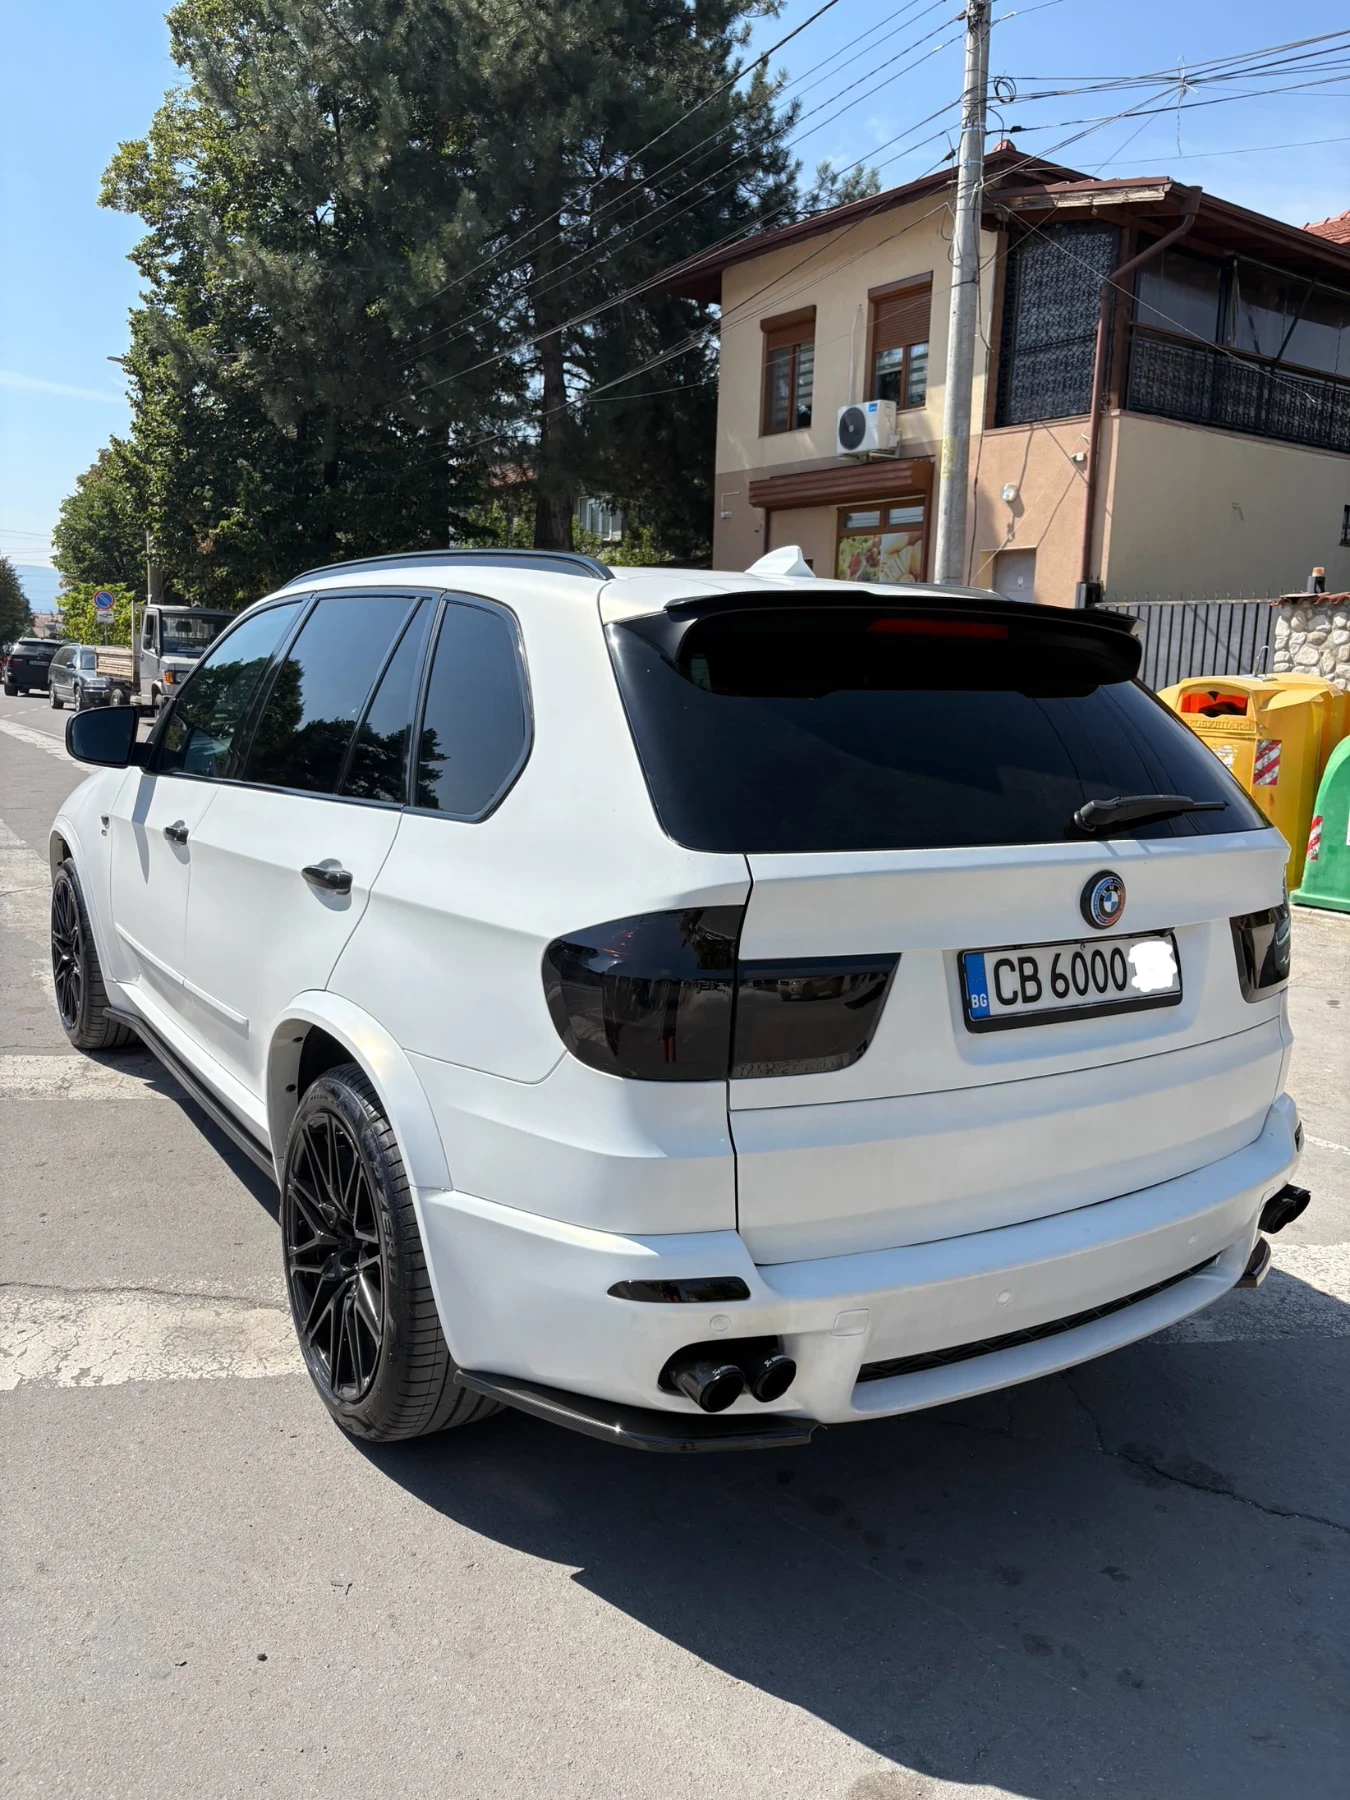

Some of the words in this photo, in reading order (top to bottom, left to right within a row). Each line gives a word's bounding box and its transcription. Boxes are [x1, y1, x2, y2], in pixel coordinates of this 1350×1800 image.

[1102, 885, 1121, 897] BMW
[993, 956, 1042, 1006] CB
[1051, 947, 1127, 999] 6000
[971, 993, 987, 1008] BG
[377, 1187, 399, 1286] ZERO
